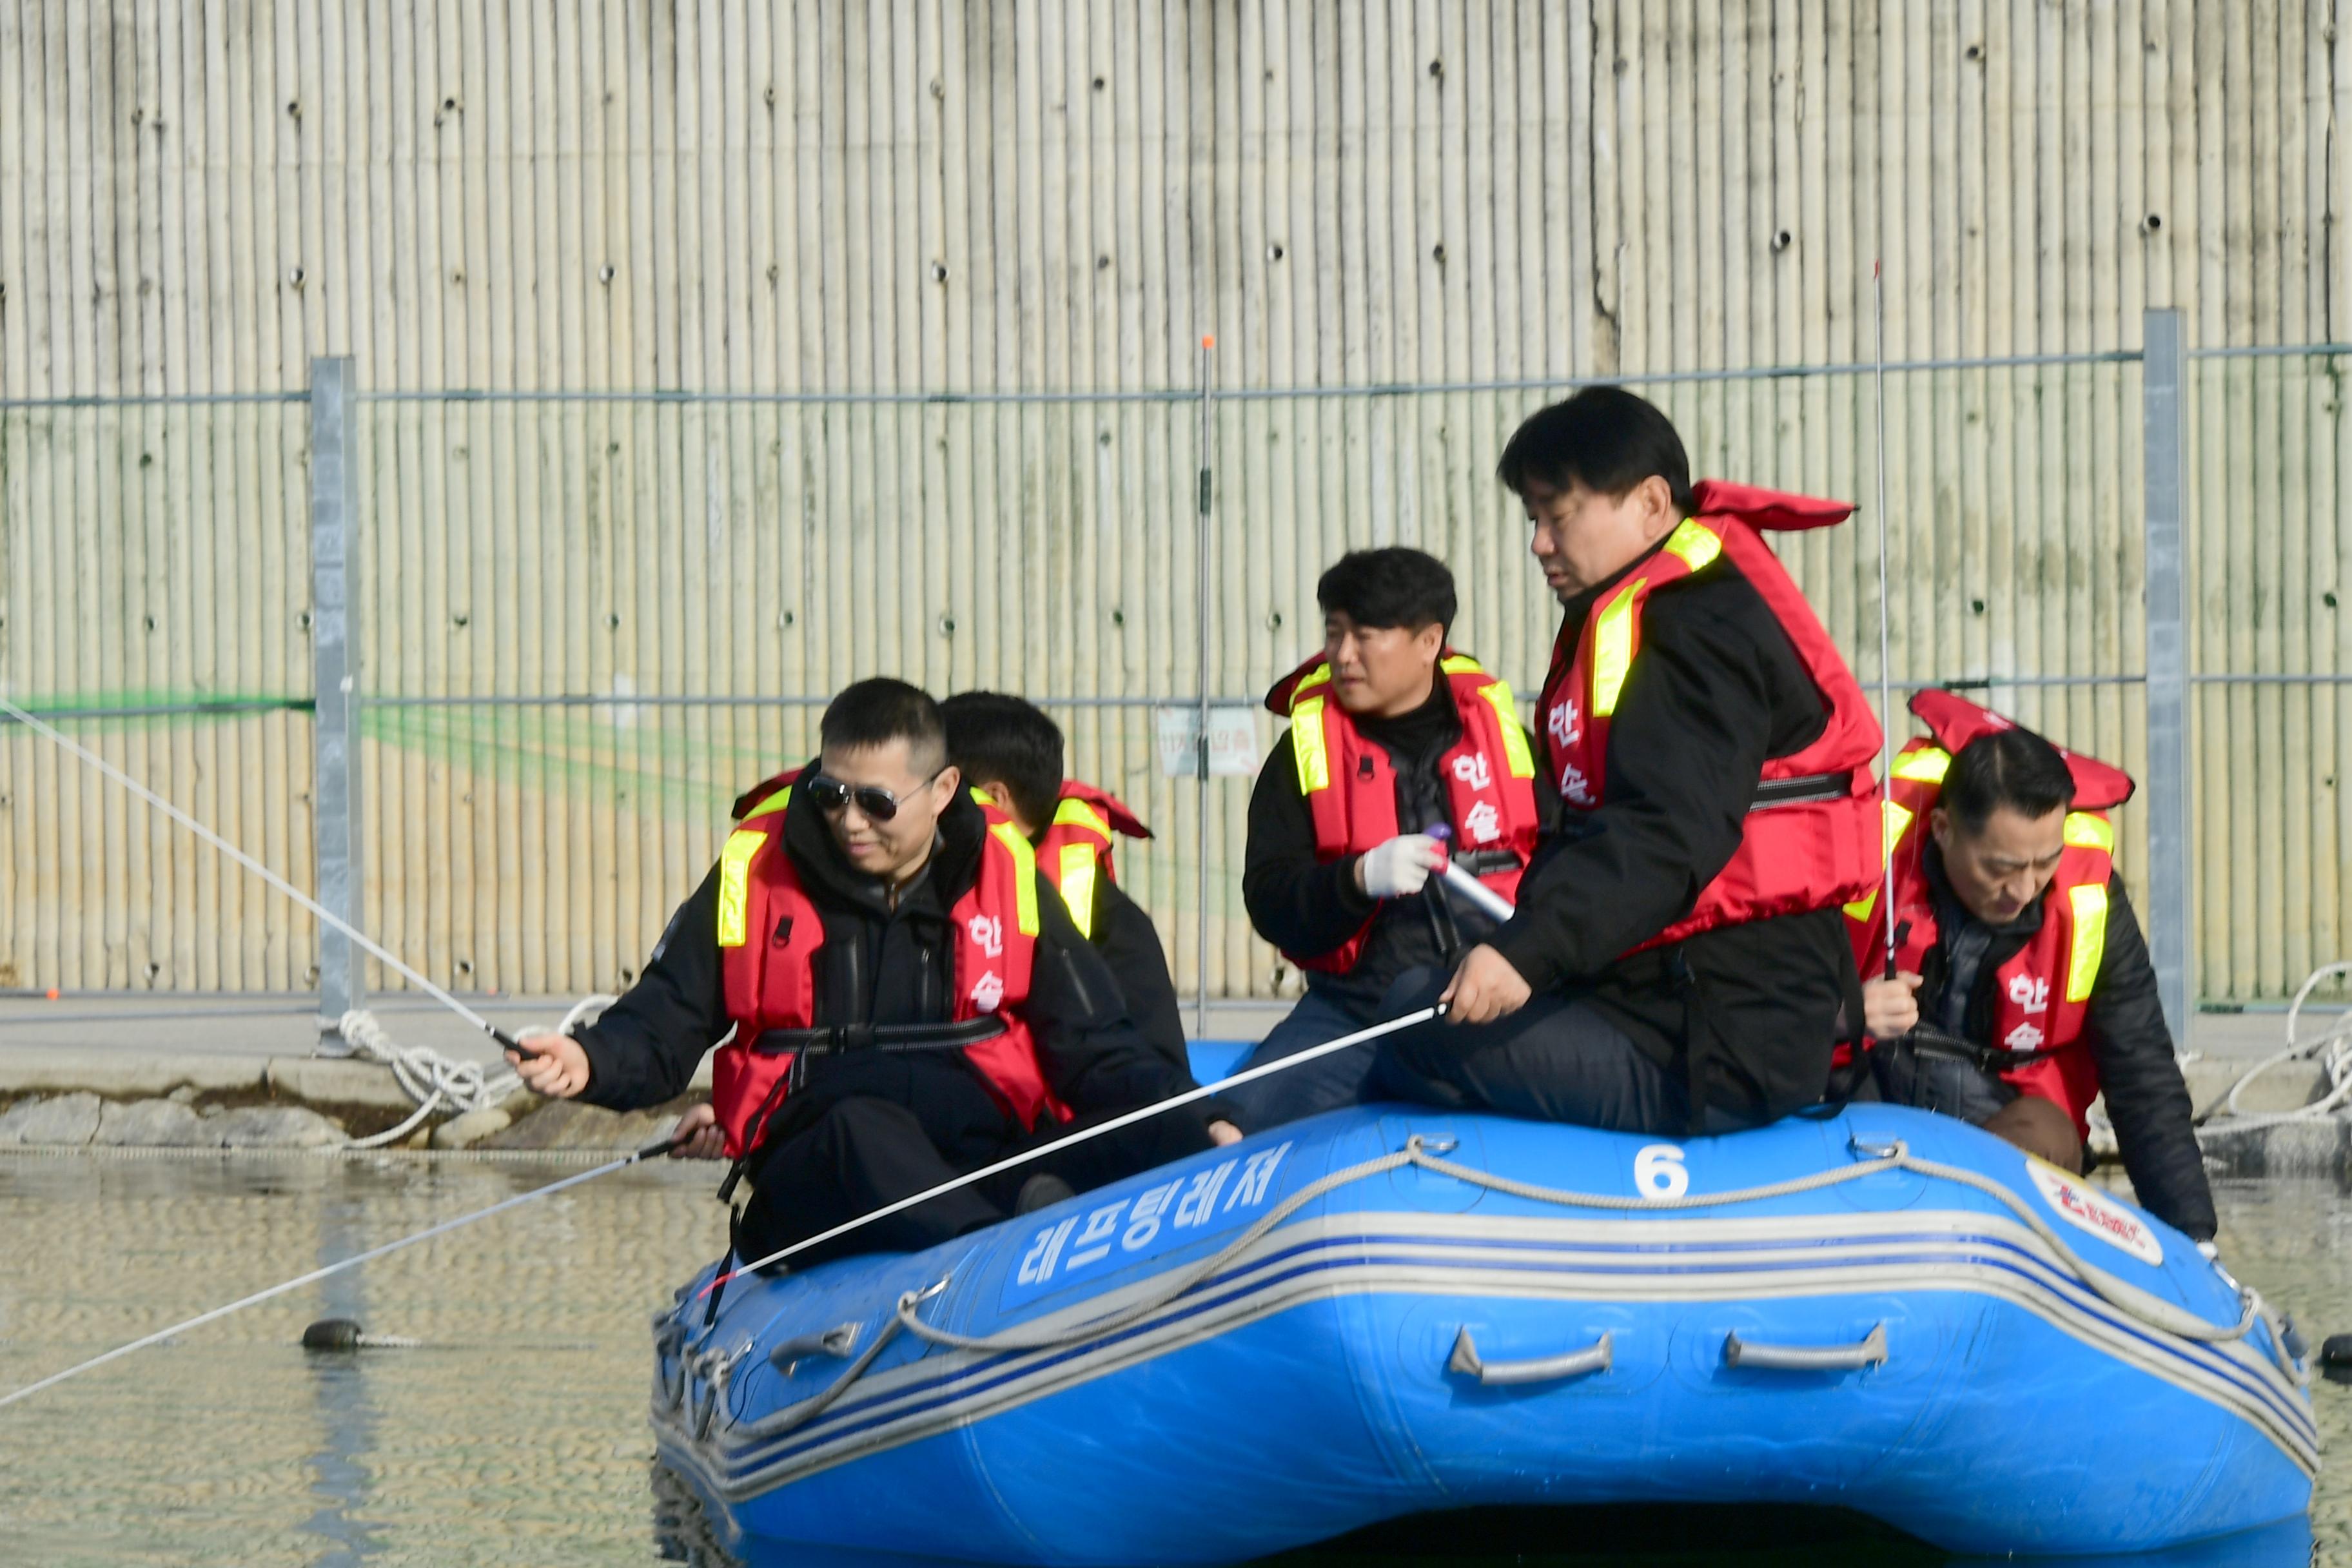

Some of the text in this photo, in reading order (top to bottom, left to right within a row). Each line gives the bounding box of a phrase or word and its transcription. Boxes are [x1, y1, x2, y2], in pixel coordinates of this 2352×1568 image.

[1452, 751, 1501, 844] 한솔
[1548, 698, 1597, 805] 한솔
[968, 914, 1004, 1013] 한솔
[1634, 1143, 1689, 1200] 6
